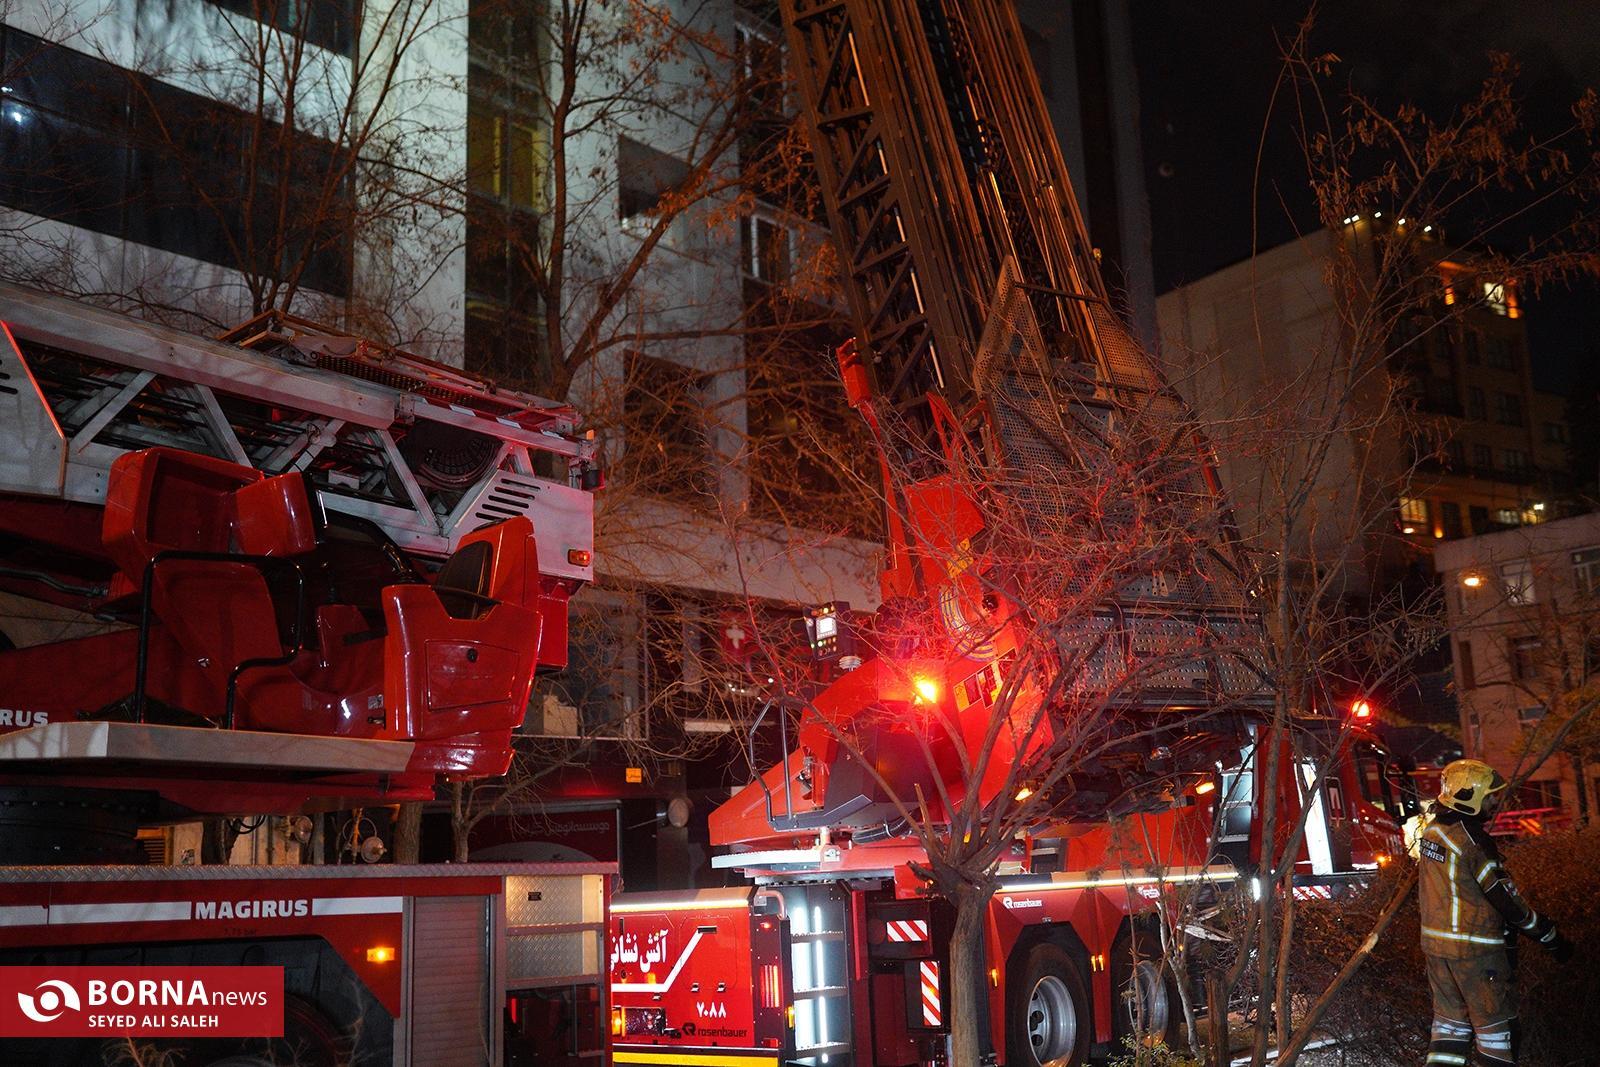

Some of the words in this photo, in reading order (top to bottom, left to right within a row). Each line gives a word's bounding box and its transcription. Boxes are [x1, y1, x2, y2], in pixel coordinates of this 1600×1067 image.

[195, 899, 308, 920] MAGIRUS
[640, 929, 668, 973] آتش
[697, 1026, 748, 1037] rosenbauer
